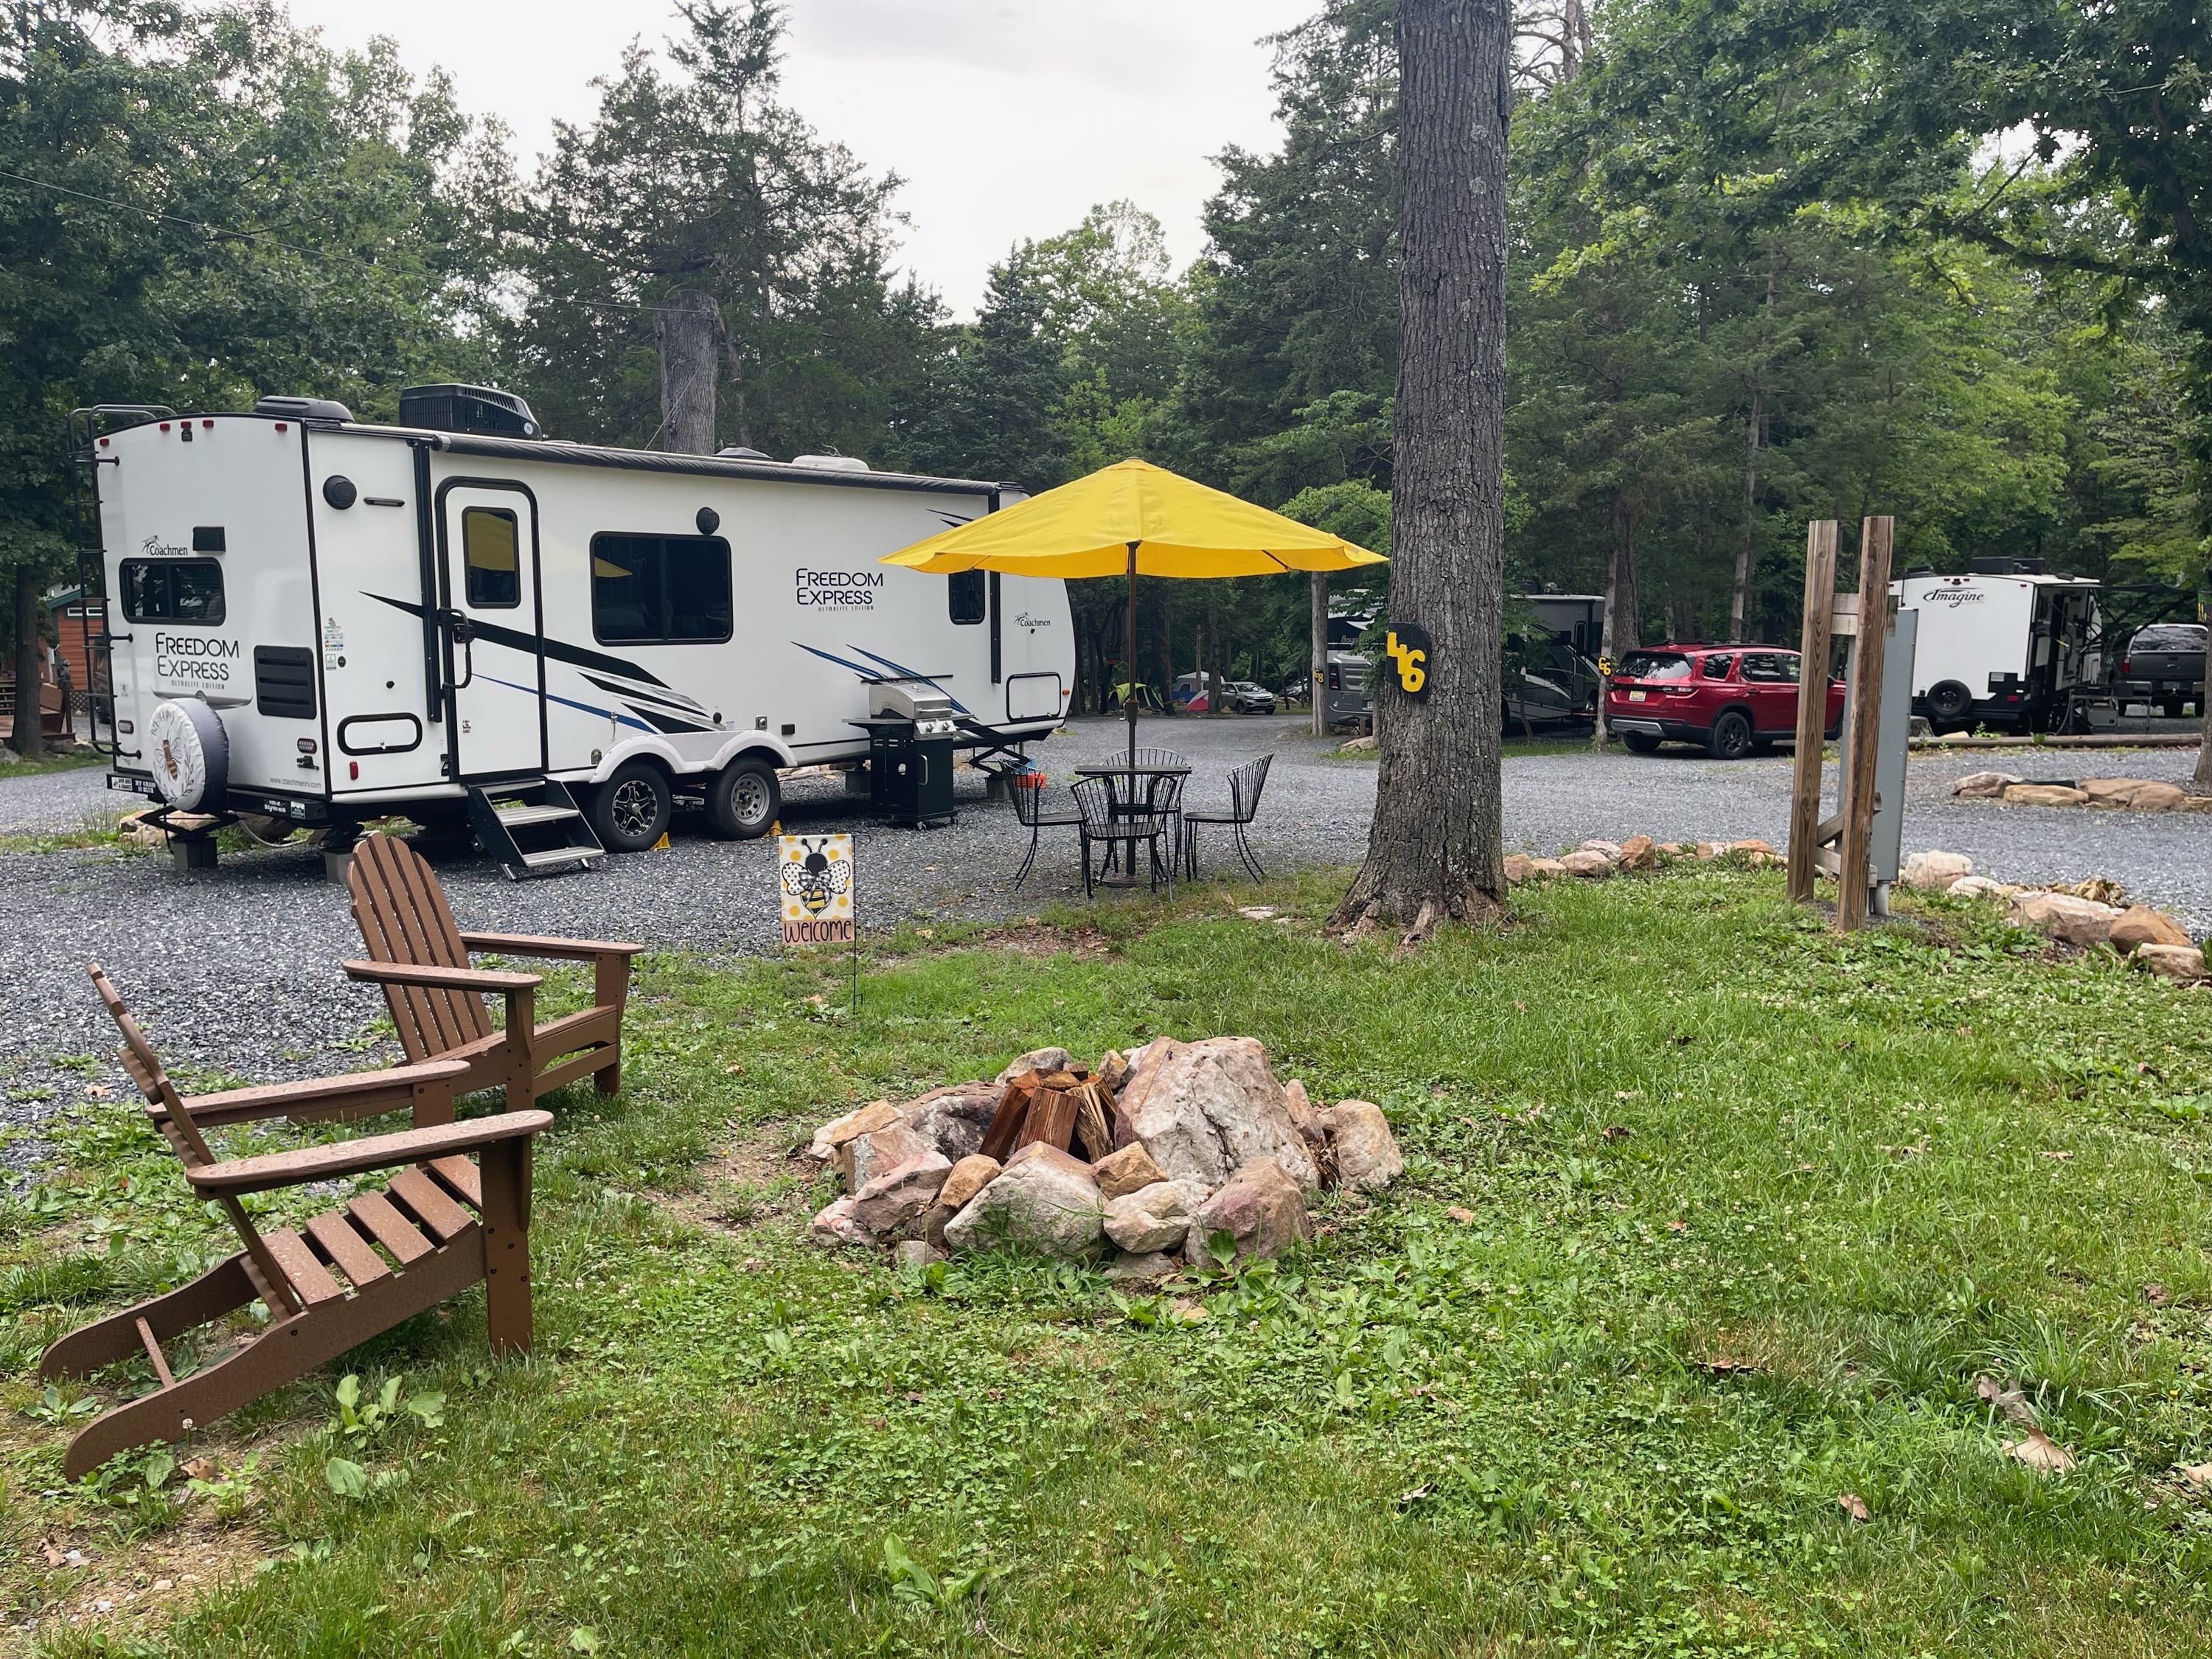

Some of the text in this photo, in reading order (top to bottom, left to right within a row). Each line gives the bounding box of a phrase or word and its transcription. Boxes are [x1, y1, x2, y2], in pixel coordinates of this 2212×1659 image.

[150, 544, 188, 556] Coachmen
[796, 568, 883, 587] FREEDOM
[796, 587, 873, 605] EXPRESS
[1923, 588, 1985, 608] Imagine
[1020, 618, 1051, 627] Coachmen
[156, 632, 240, 658] FREEDOM
[157, 655, 229, 681] EXPRESS
[1387, 632, 1426, 692] 46
[1599, 656, 1611, 676] 66
[171, 680, 226, 690] ULTRALITE EDITION
[1315, 669, 1324, 683] 68
[269, 777, 321, 788] www.coachmenrv.com
